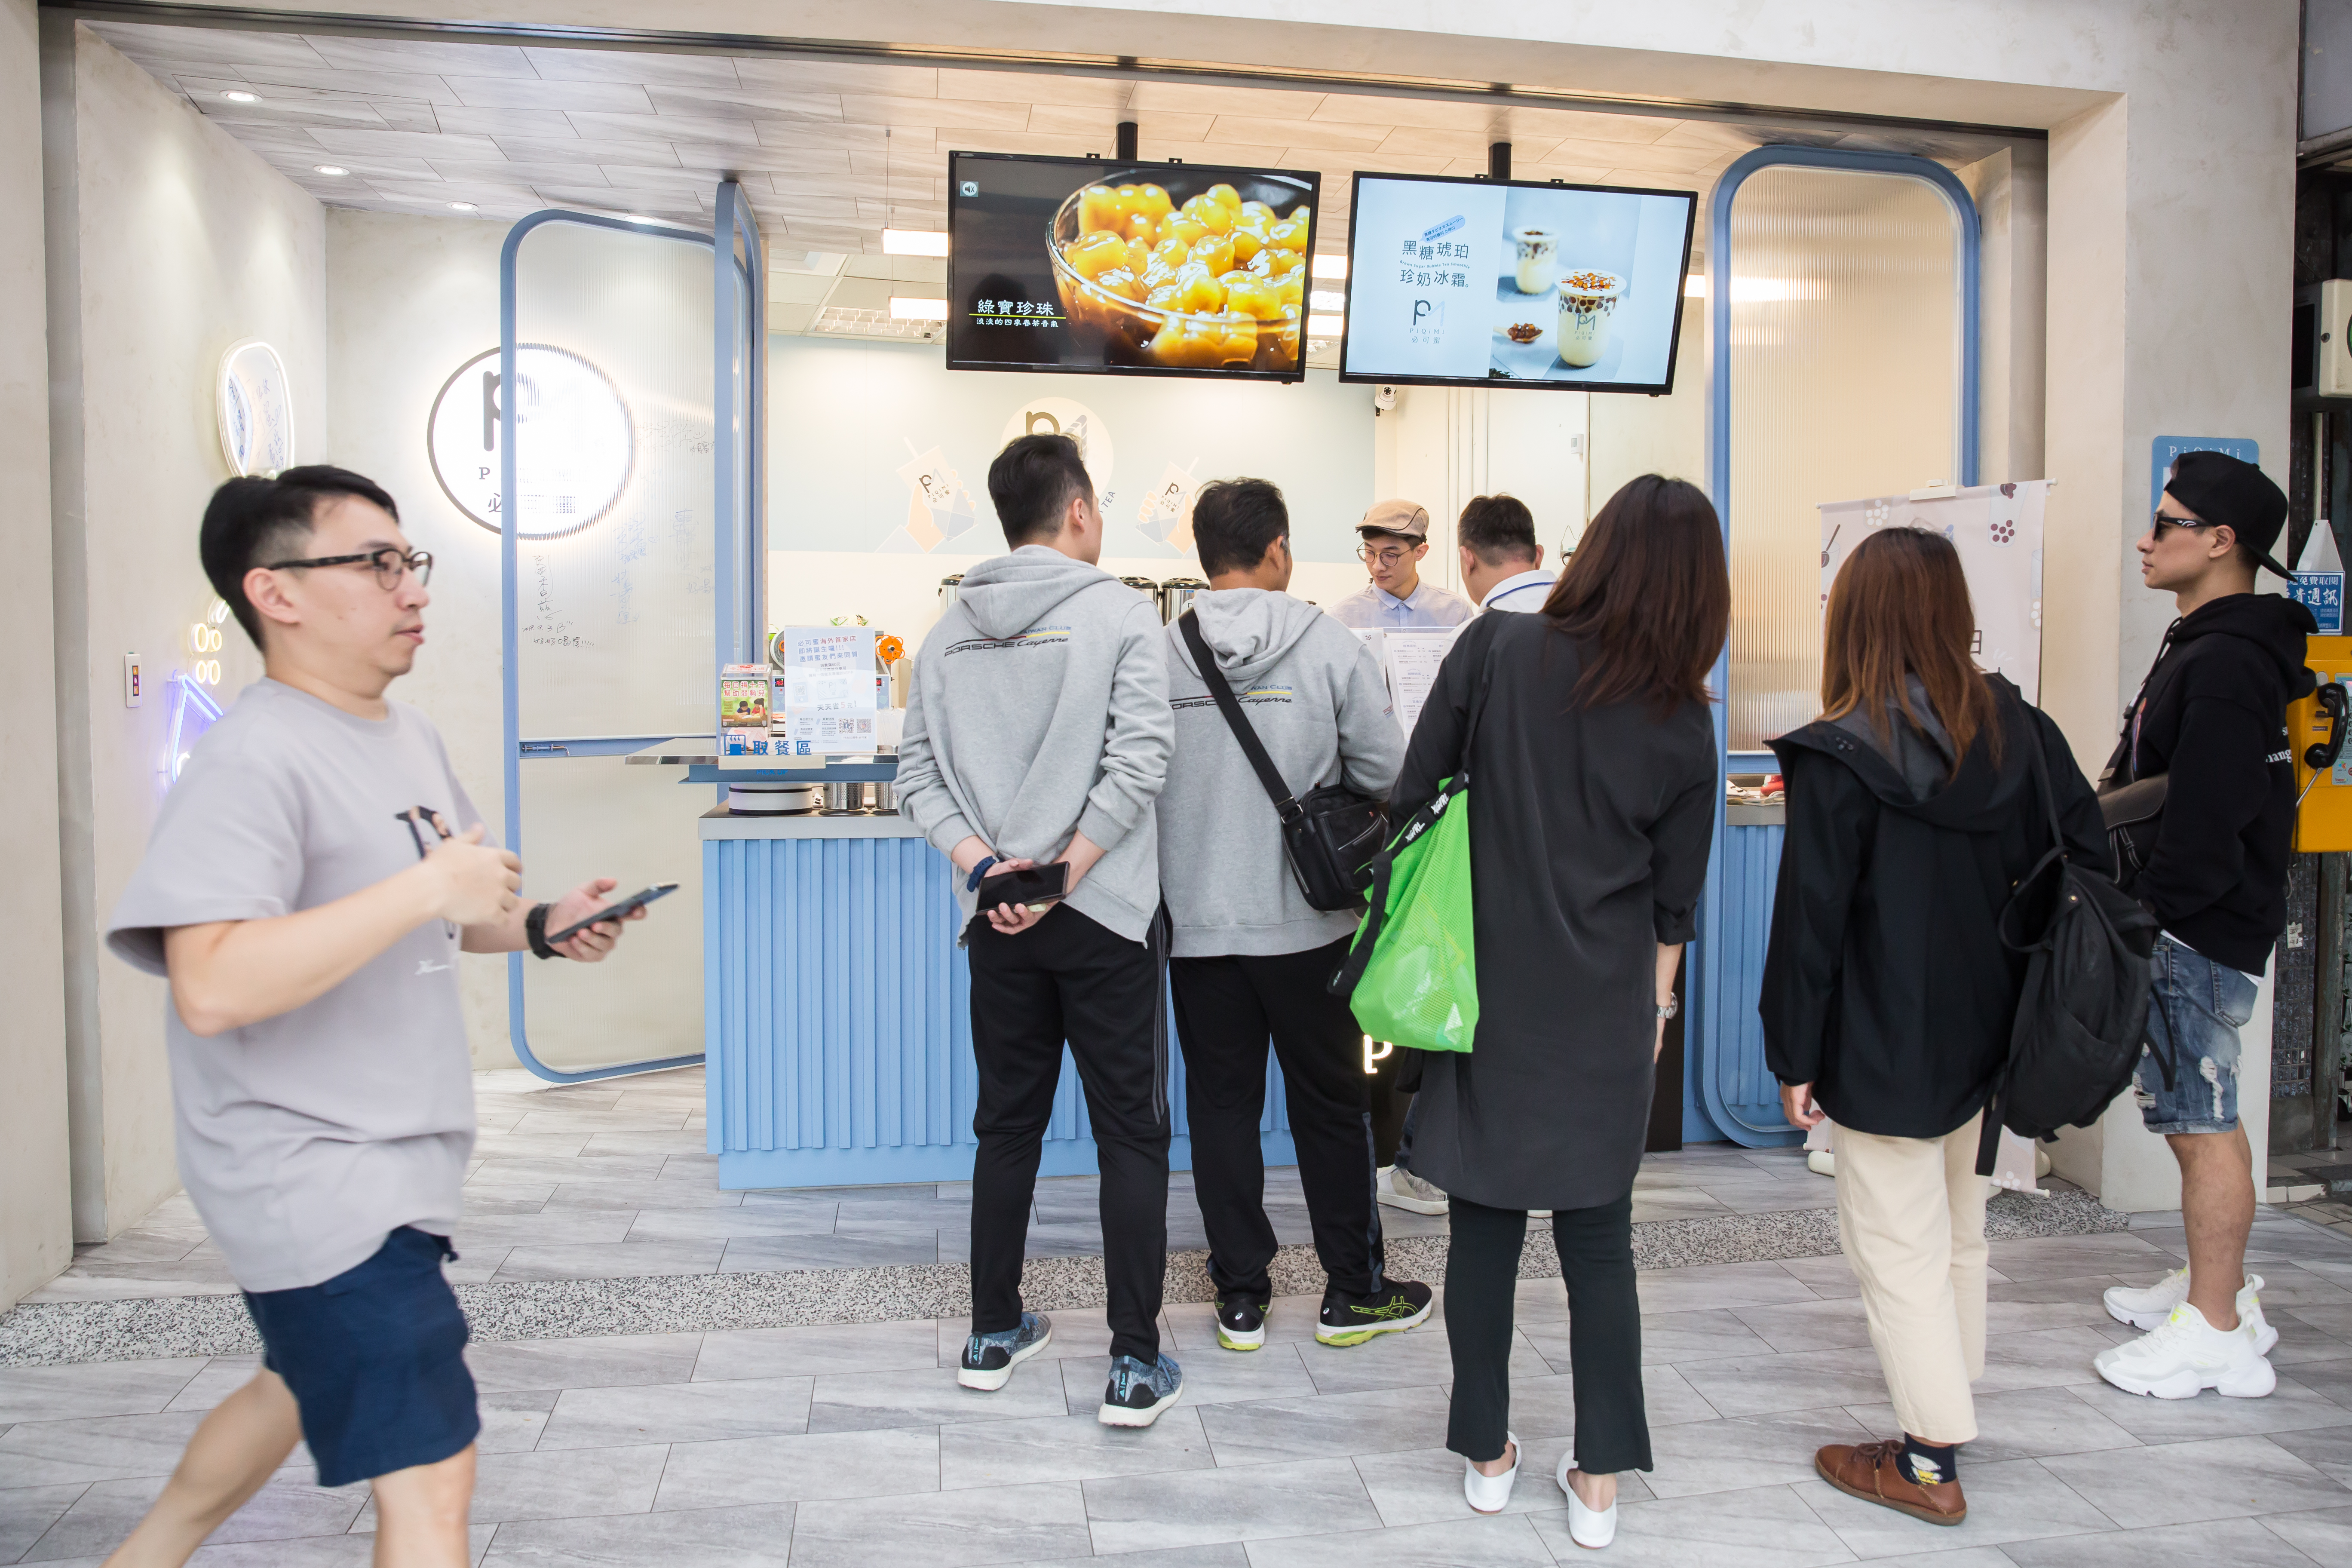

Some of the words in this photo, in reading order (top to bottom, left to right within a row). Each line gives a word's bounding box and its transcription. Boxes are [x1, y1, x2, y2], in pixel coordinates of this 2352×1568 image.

[1402, 240, 1469, 261] 黑糖琥珀
[977, 299, 1054, 316] 綠寶珍珠
[976, 317, 1059, 328] 淡淡的四季春茶香氣
[1411, 335, 1441, 344] 必可蜜
[1101, 491, 1116, 508] TEA
[797, 635, 856, 647] 必可蜜海外首家店
[944, 641, 1015, 658] PORSCHE
[1017, 638, 1068, 648] Cayenne
[800, 651, 858, 663] 邀請蜜友們來同賀
[1171, 700, 1219, 710] ORSC
[1238, 696, 1292, 706] Cayenne
[752, 740, 812, 755] 取餐區
